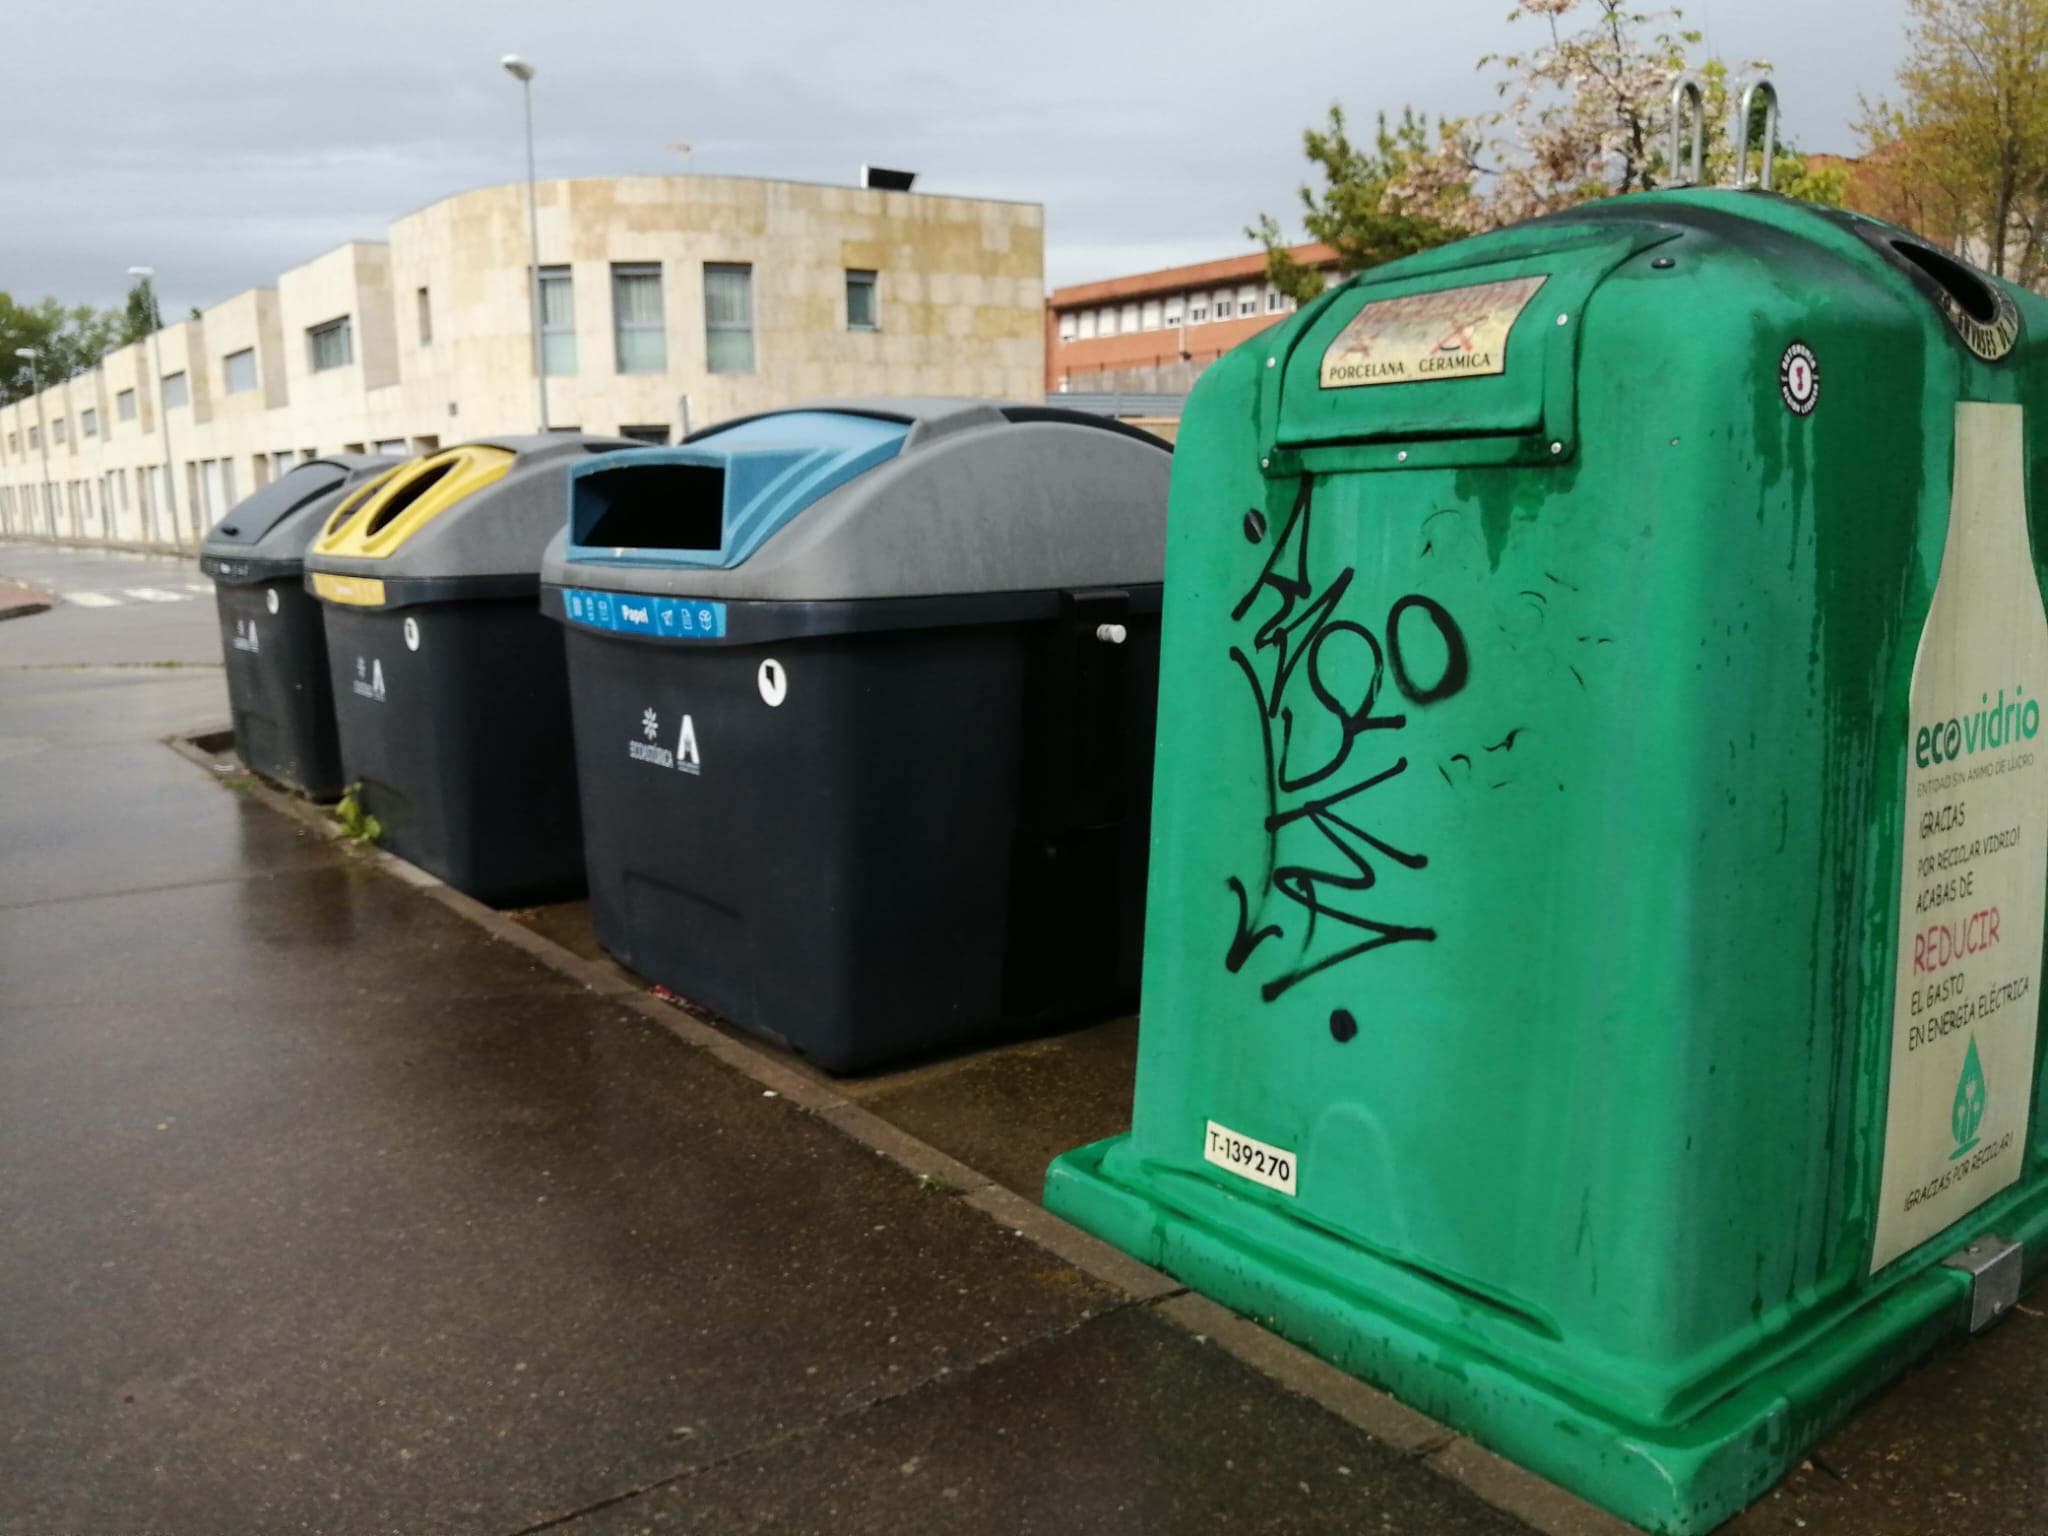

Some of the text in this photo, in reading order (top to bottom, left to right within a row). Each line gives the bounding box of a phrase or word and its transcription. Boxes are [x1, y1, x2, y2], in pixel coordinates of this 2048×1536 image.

[1329, 361, 1404, 380] PORCELANA
[1915, 685, 2040, 769] ecovidrio
[1916, 772, 1950, 798] ENTIDAD
[1950, 768, 1966, 787] SIN
[1995, 759, 2007, 774] DE
[1917, 824, 2021, 880] POR RECICLAR VIDRIO!
[1915, 871, 1974, 914] ACABAS DE
[1912, 907, 2000, 976] REDUCIR
[1908, 976, 2029, 1052] EN ENERGÍA ELÉCTRICA
[1910, 972, 1965, 1017] EL GASTO
[1210, 1131, 1290, 1181] T-139270
[1952, 1163, 1970, 1188] POR
